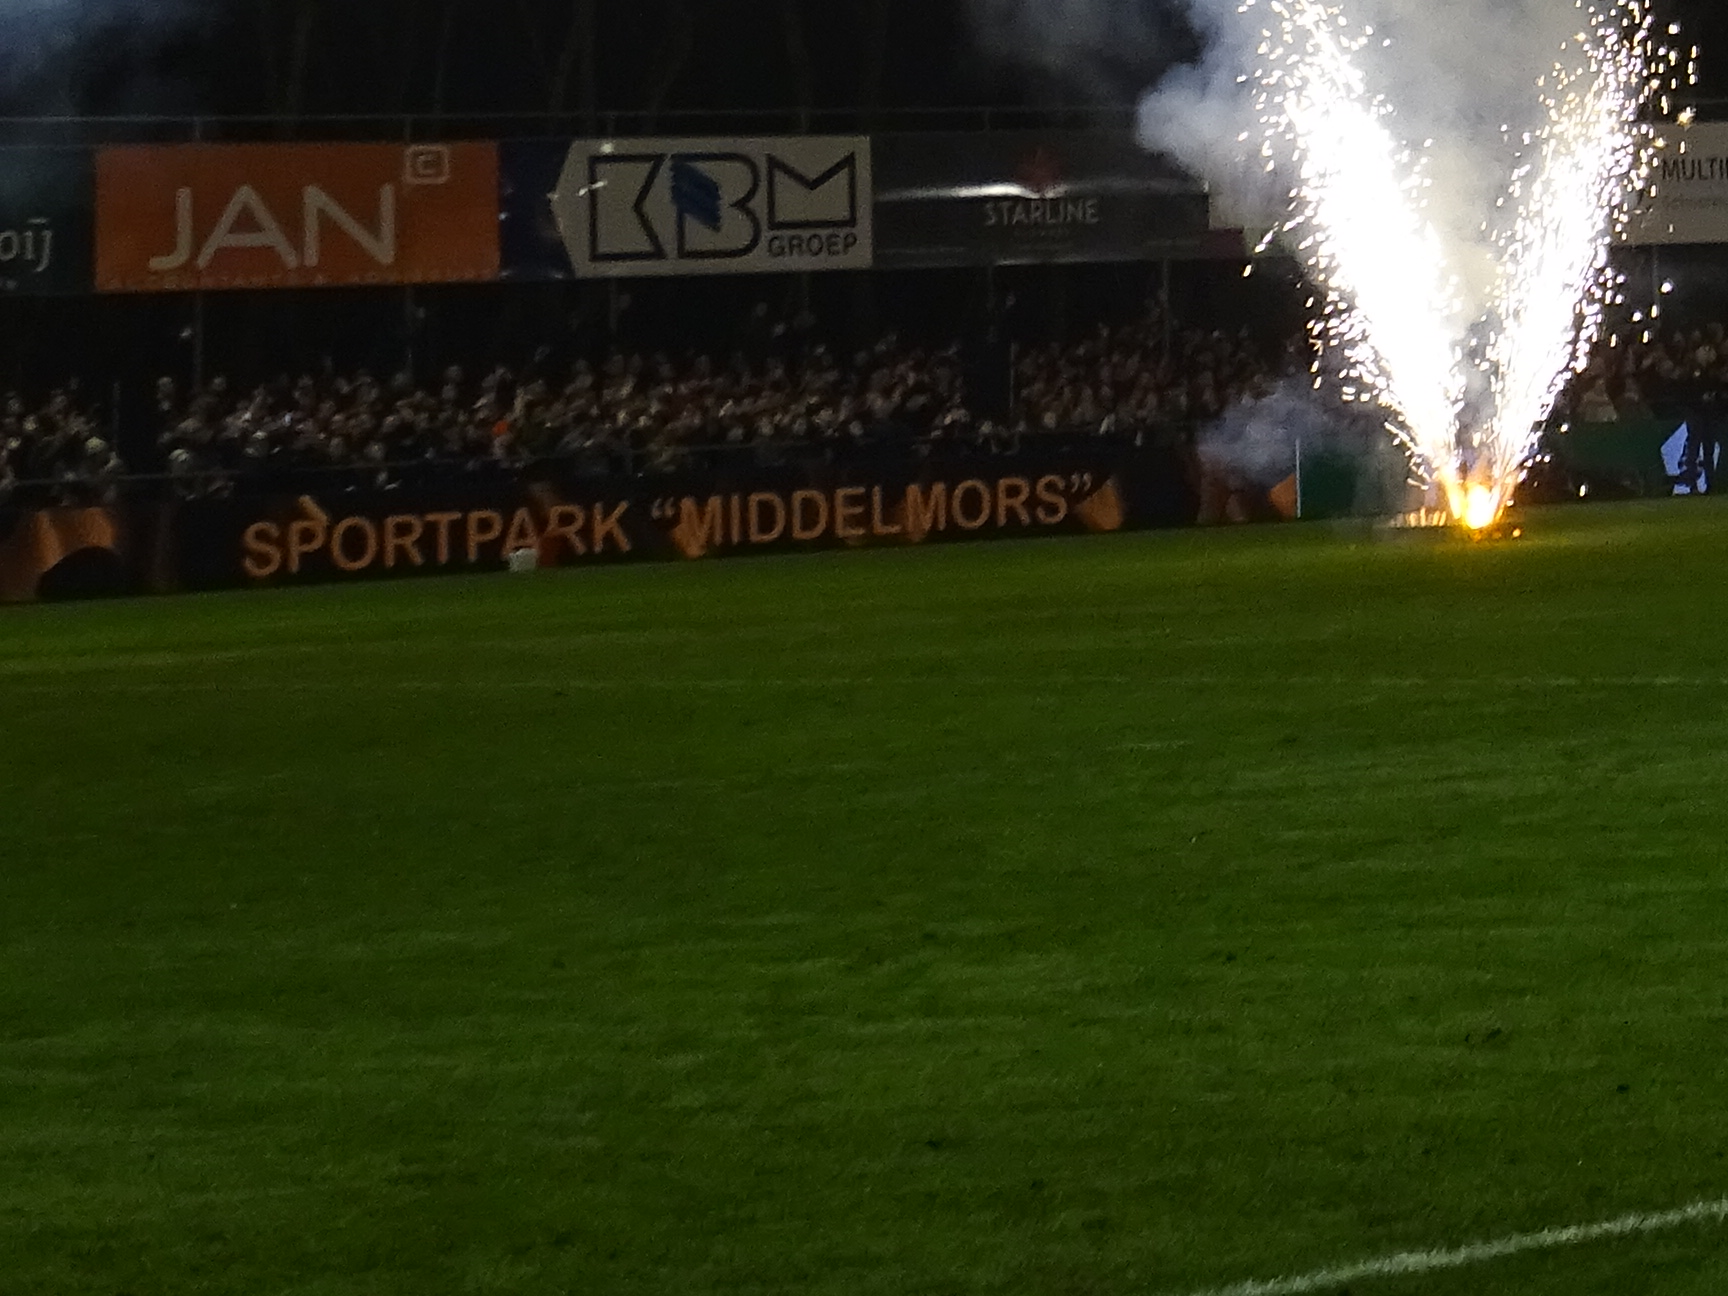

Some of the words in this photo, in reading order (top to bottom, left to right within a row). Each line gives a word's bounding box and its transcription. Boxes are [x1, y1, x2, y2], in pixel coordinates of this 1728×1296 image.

[148, 183, 396, 271] JAN
[588, 152, 856, 262] KBM
[767, 232, 857, 258] GROEP
[983, 197, 1100, 227] STARLINE
[241, 500, 632, 580] SPORTPARK
